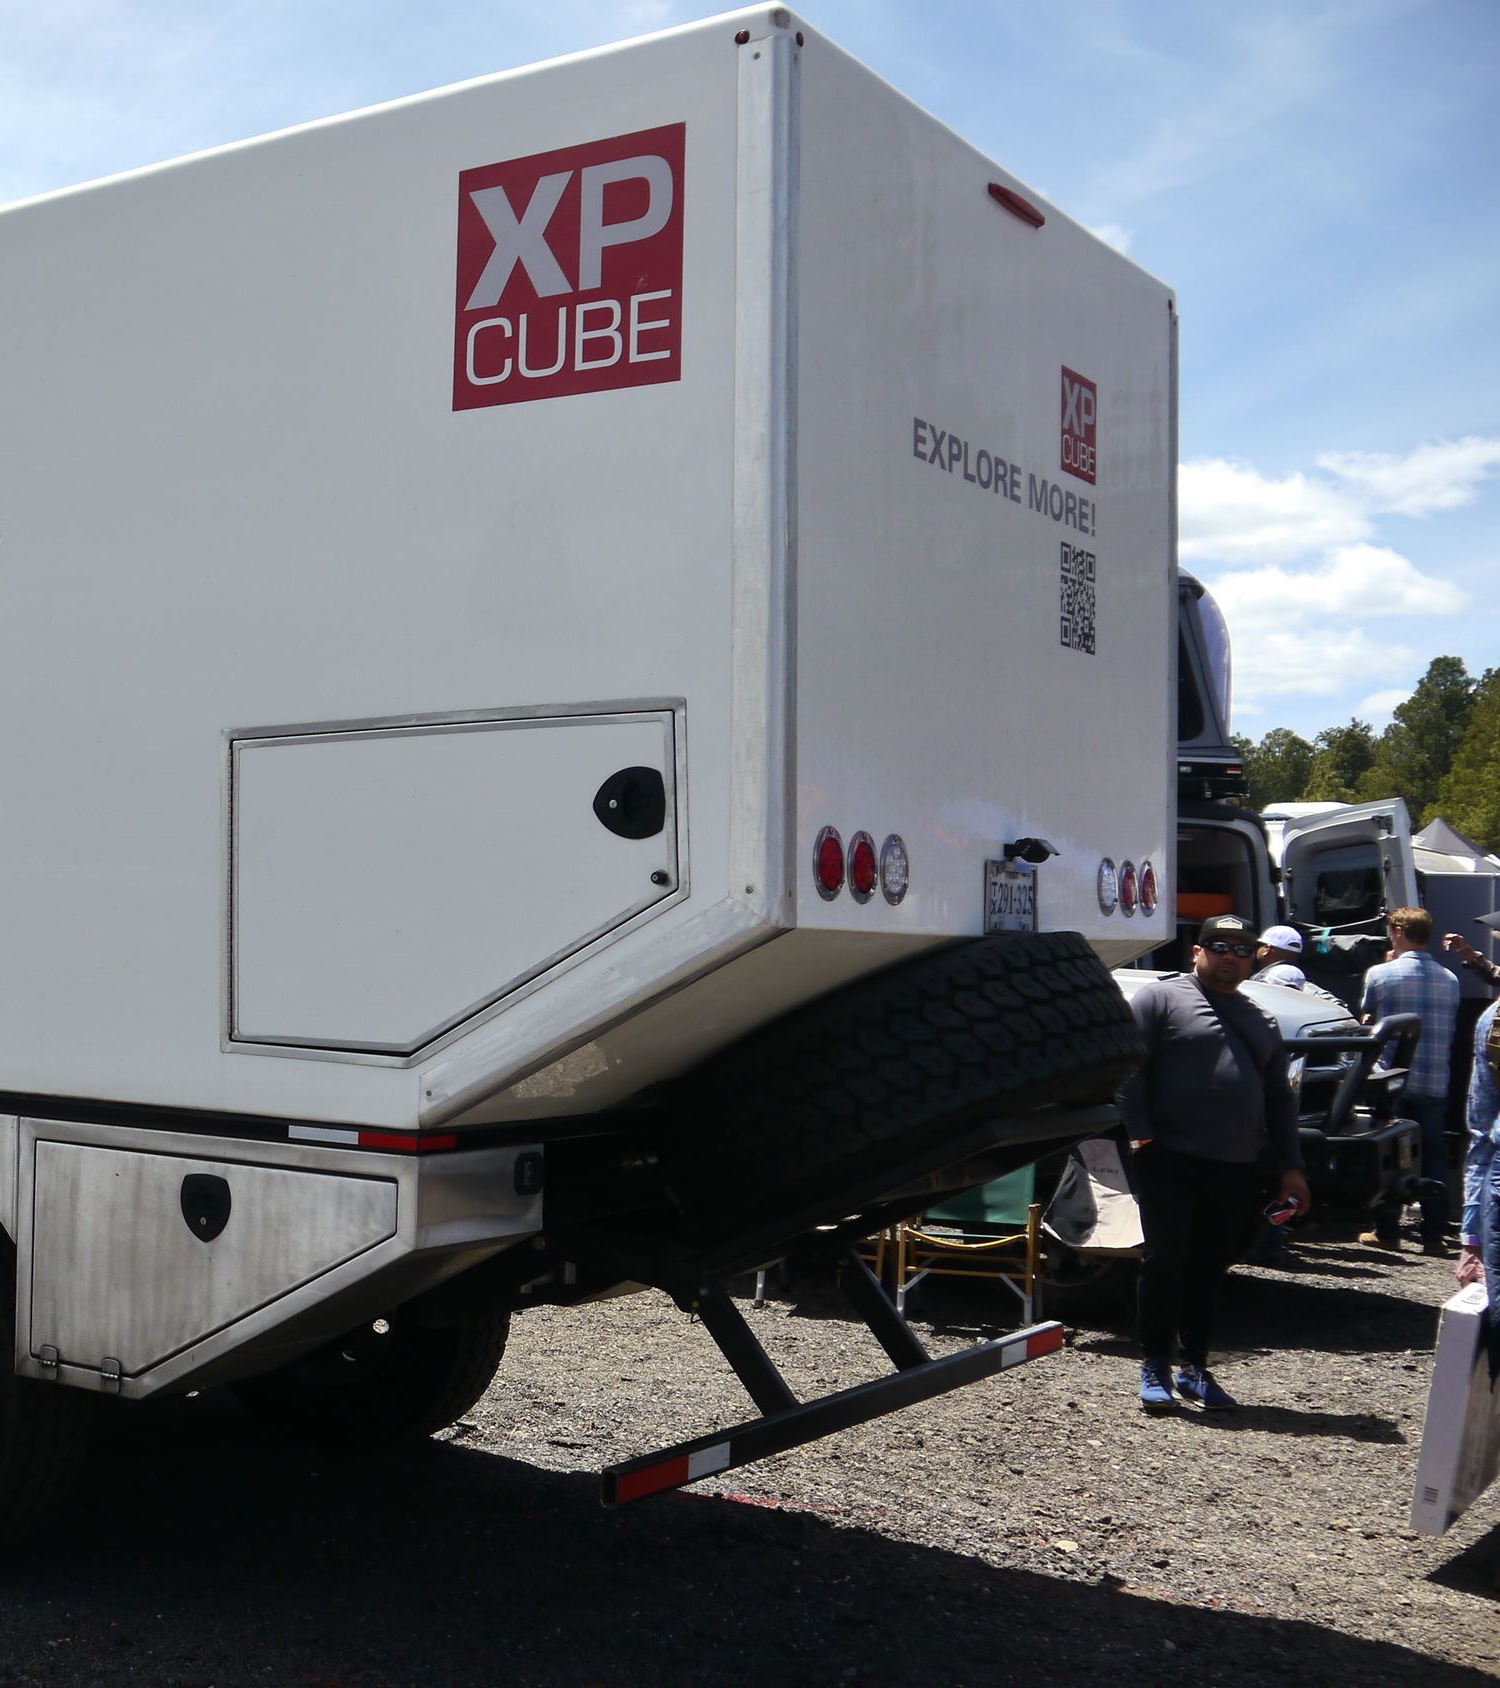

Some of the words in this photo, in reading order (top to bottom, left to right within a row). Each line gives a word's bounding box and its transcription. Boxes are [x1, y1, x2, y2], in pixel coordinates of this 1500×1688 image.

[464, 154, 674, 312] XP
[465, 288, 672, 386] CUBE
[1062, 376, 1096, 438] XP
[1062, 433, 1096, 476] CUBE
[913, 416, 1022, 504] EXPLORE
[1028, 472, 1096, 537] MORE!
